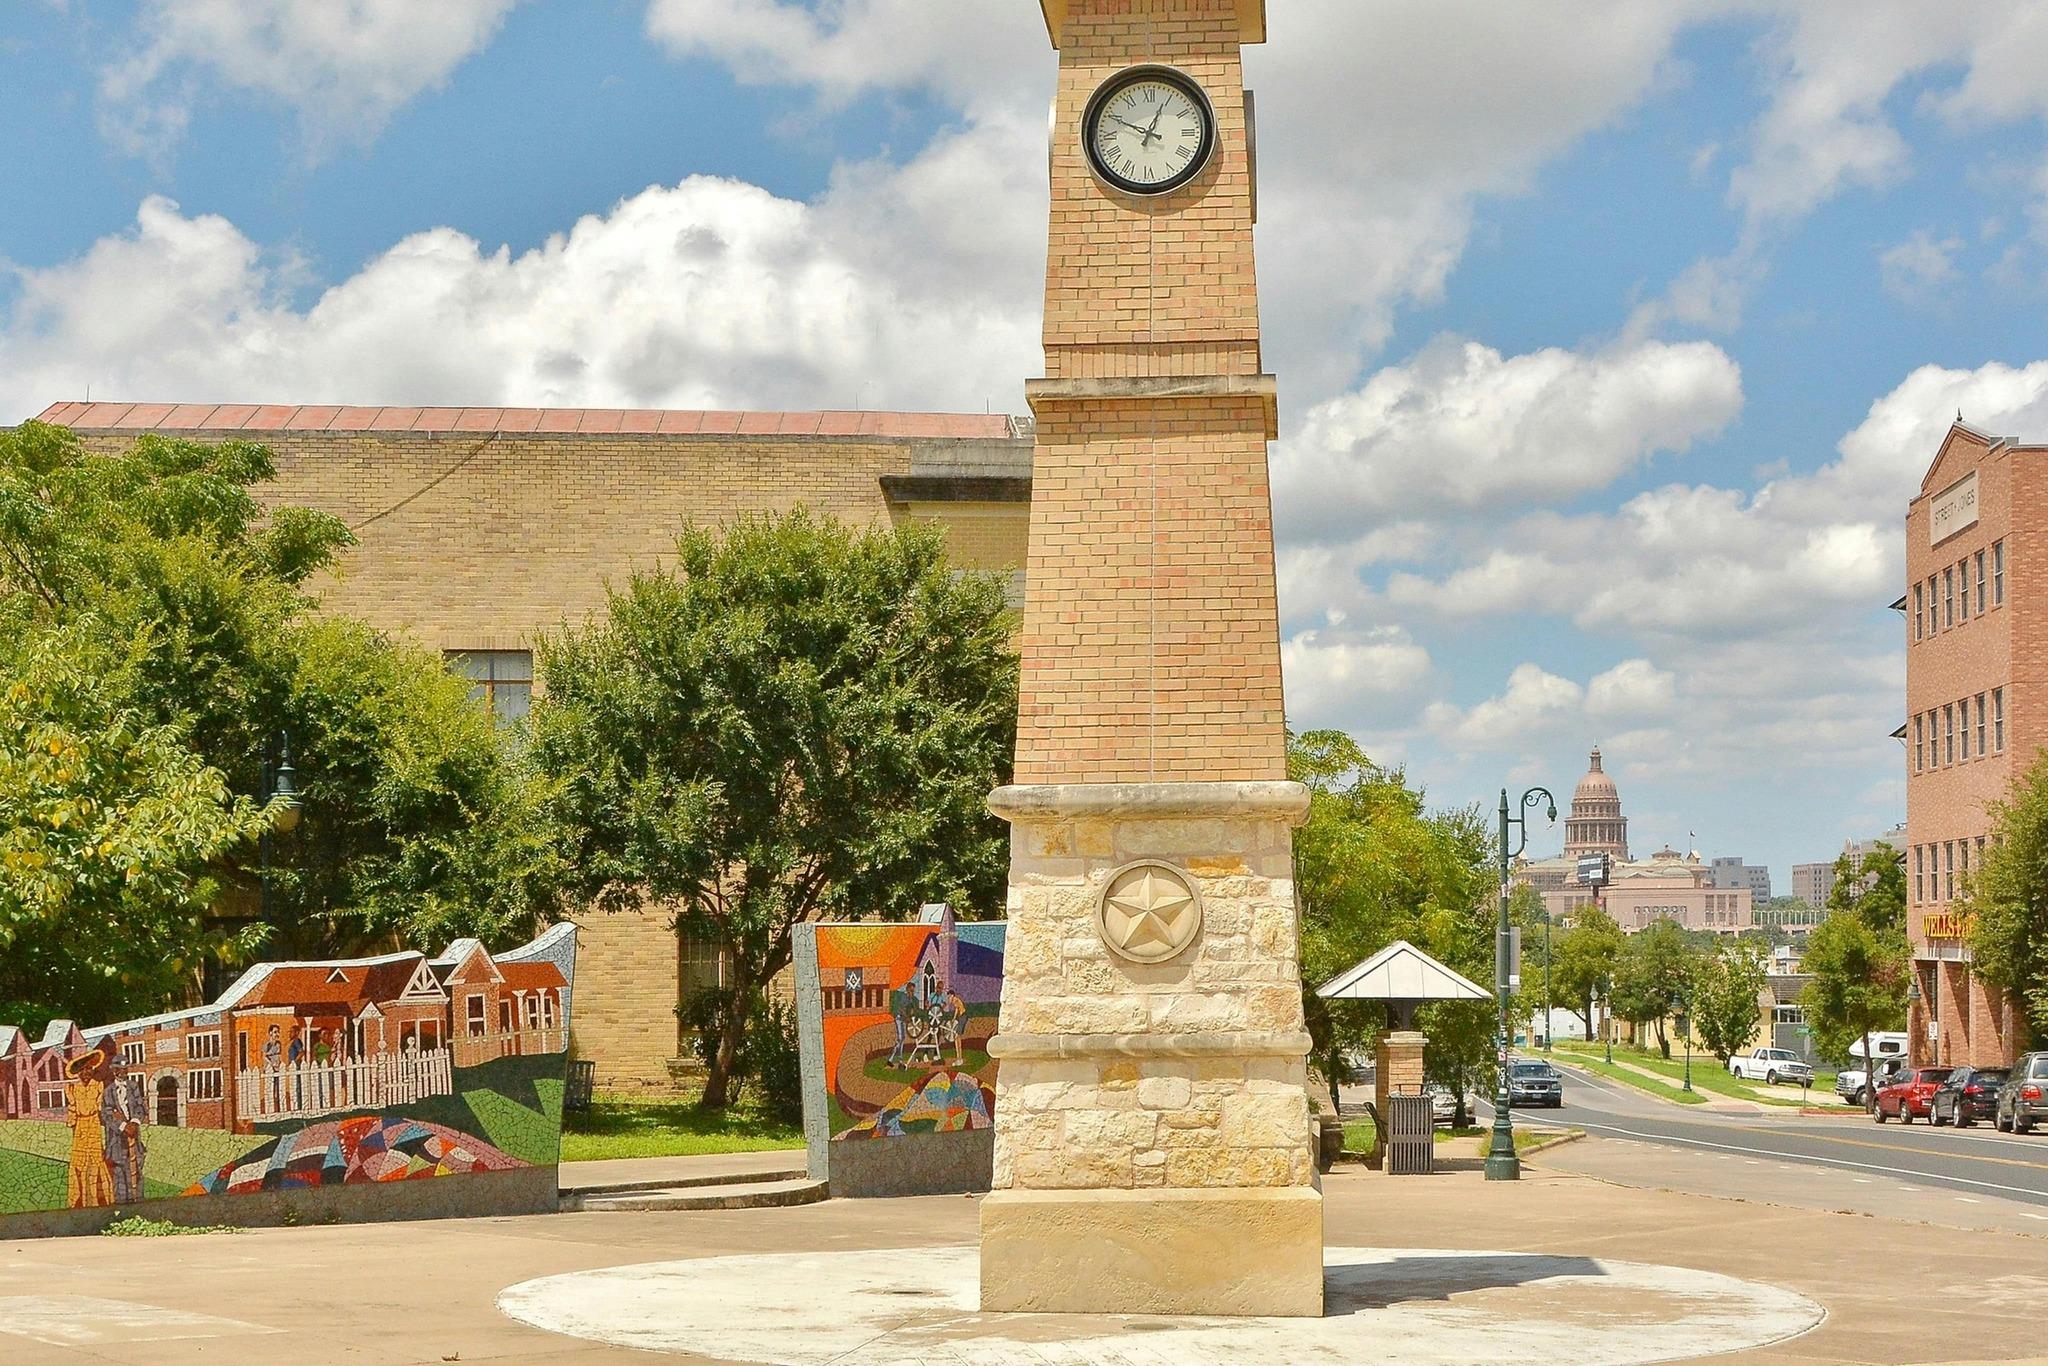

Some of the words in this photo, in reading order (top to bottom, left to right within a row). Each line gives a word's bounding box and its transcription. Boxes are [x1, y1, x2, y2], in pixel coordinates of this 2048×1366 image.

[1122, 95, 1136, 110] XI
[1143, 89, 1155, 102] XII
[1176, 109, 1190, 119] II
[1103, 130, 1118, 141] IX
[1181, 128, 1196, 137] III
[1106, 144, 1122, 164] VIII
[1121, 159, 1136, 177] VII
[1144, 165, 1155, 179] VI
[1923, 914, 1954, 937] WELLS
